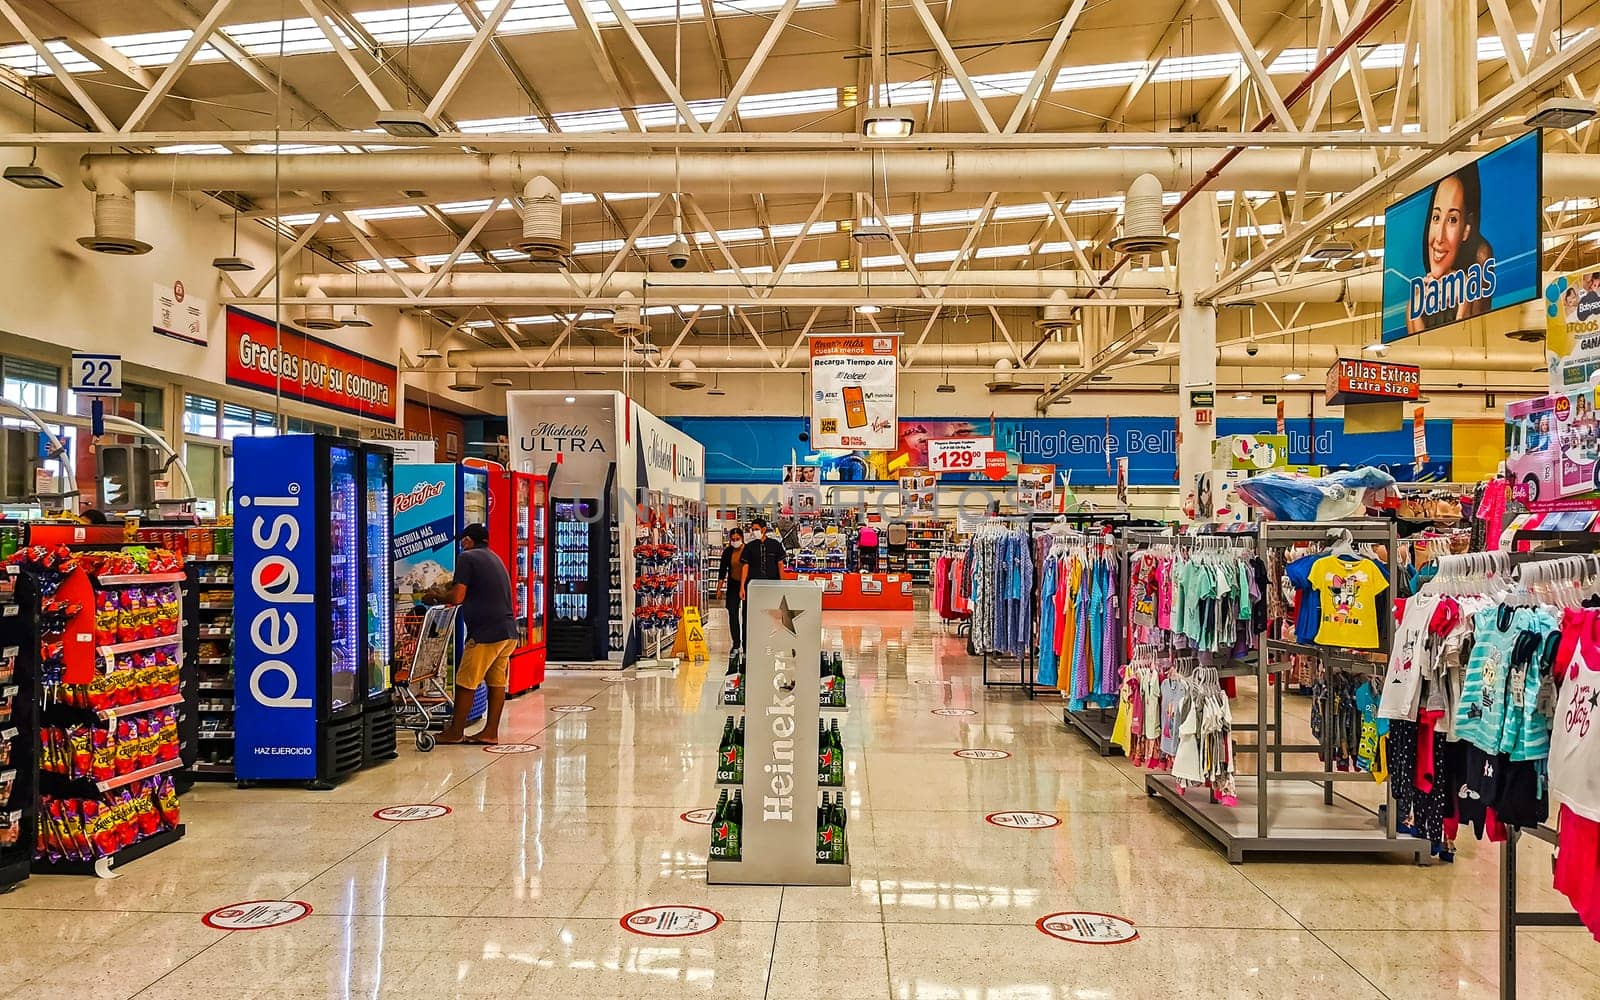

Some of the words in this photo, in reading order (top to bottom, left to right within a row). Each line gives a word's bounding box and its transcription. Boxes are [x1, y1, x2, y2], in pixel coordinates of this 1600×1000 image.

[1409, 258, 1497, 320] Damas
[81, 360, 113, 387] 22
[239, 333, 298, 381] Gracias
[302, 357, 328, 387] por
[329, 366, 343, 392] su
[345, 372, 389, 405] compra
[815, 359, 845, 367] Recarga
[846, 359, 876, 367] Tiempo
[1341, 361, 1377, 380] Tallas
[1380, 365, 1418, 384] Extras
[1349, 379, 1380, 392] Extra
[1384, 382, 1409, 394] Size
[530, 421, 589, 438] Michelob
[520, 437, 606, 453] ULTRA
[1015, 429, 1126, 459] Higiene
[1126, 430, 1177, 454] Bell
[394, 530, 421, 548] DISFRUTA
[420, 525, 434, 539] MÁS
[394, 548, 403, 560] TU
[402, 541, 424, 556] ESTADO
[423, 531, 449, 549] NATURAL
[239, 494, 314, 708] pepsi
[254, 747, 271, 756] HAZ
[271, 747, 313, 756] EJERCICIO
